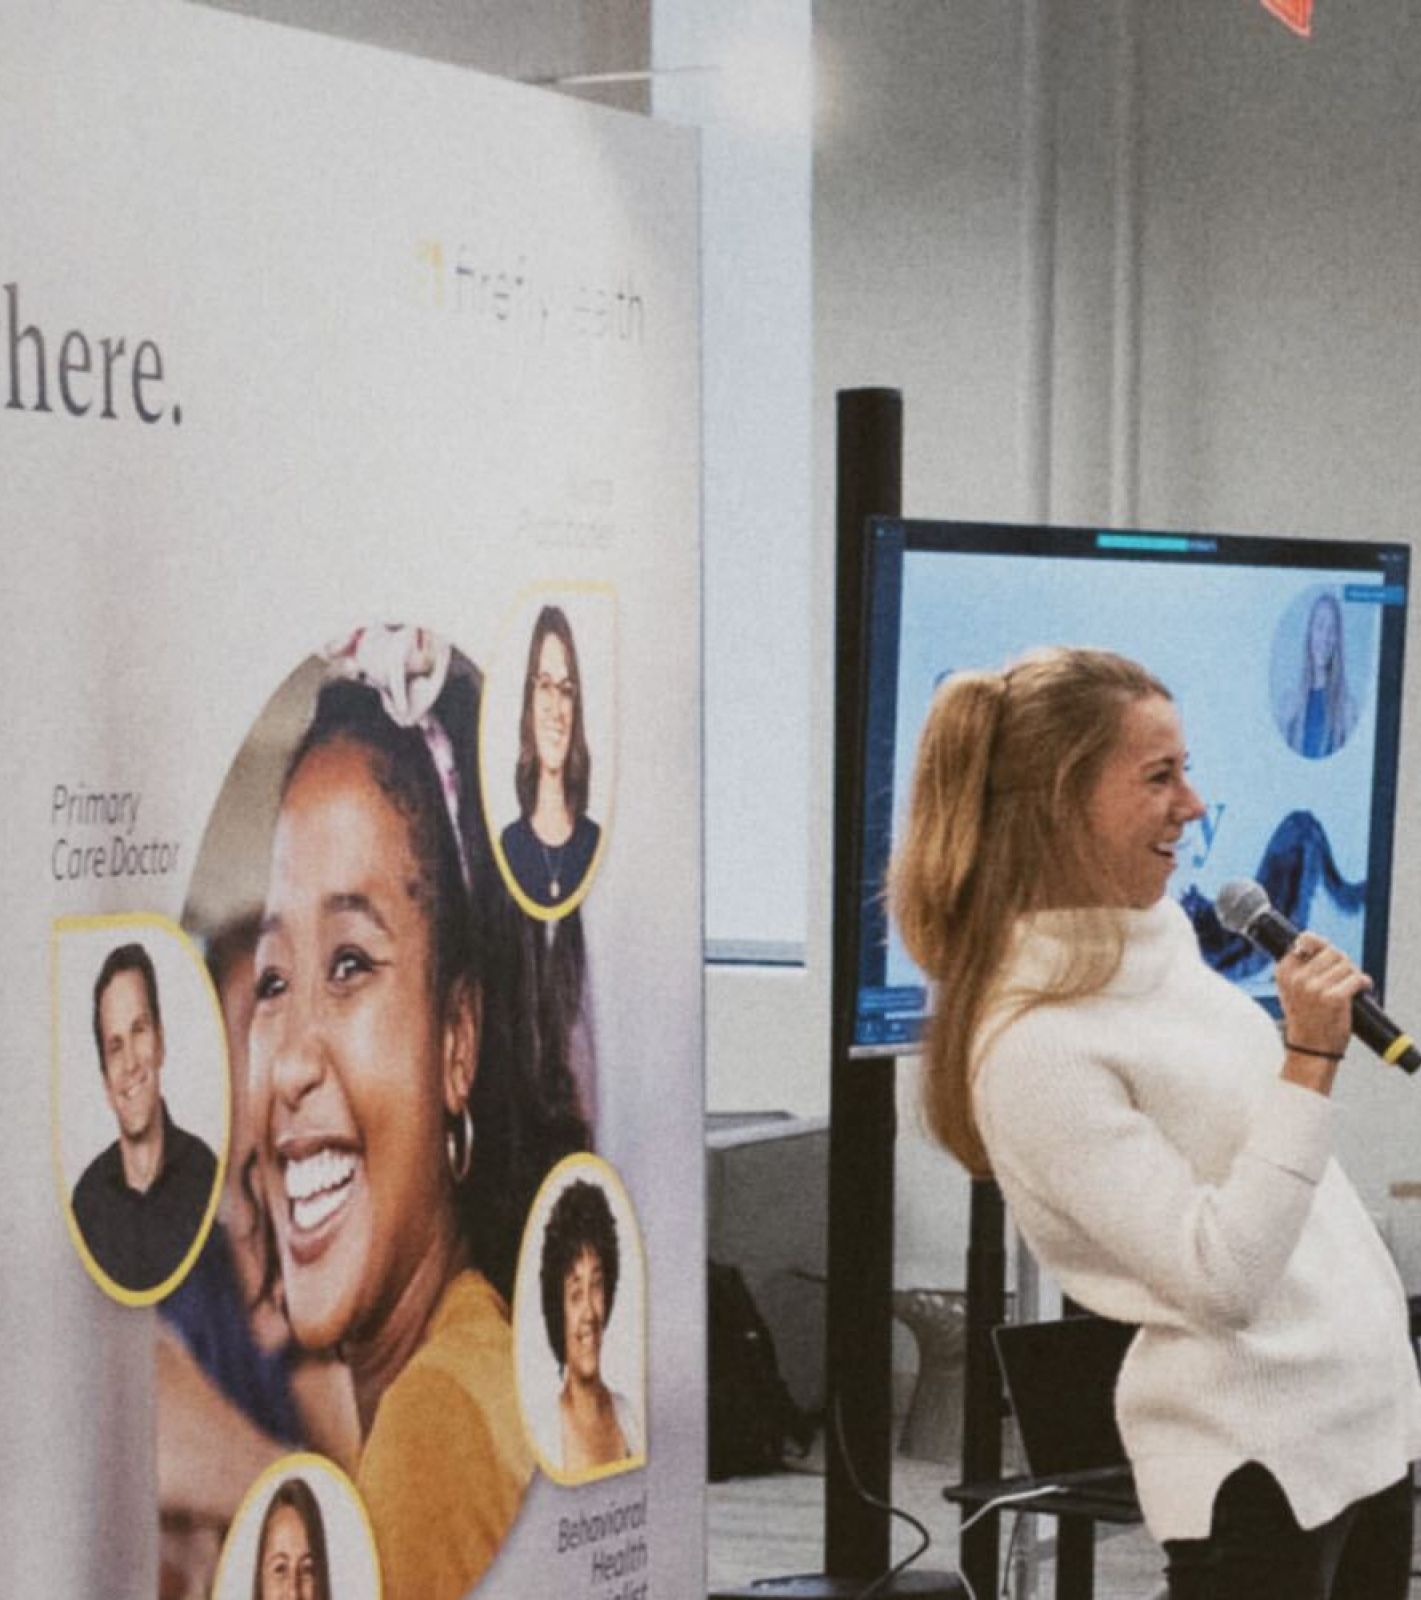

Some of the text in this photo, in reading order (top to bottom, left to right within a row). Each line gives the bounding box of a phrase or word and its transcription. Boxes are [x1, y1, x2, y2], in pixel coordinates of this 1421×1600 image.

[2, 281, 183, 426] here.
[52, 784, 141, 835] Primary
[51, 835, 180, 881] Care Doctor
[557, 1491, 647, 1554] Behavioral
[591, 1536, 648, 1584] Health
